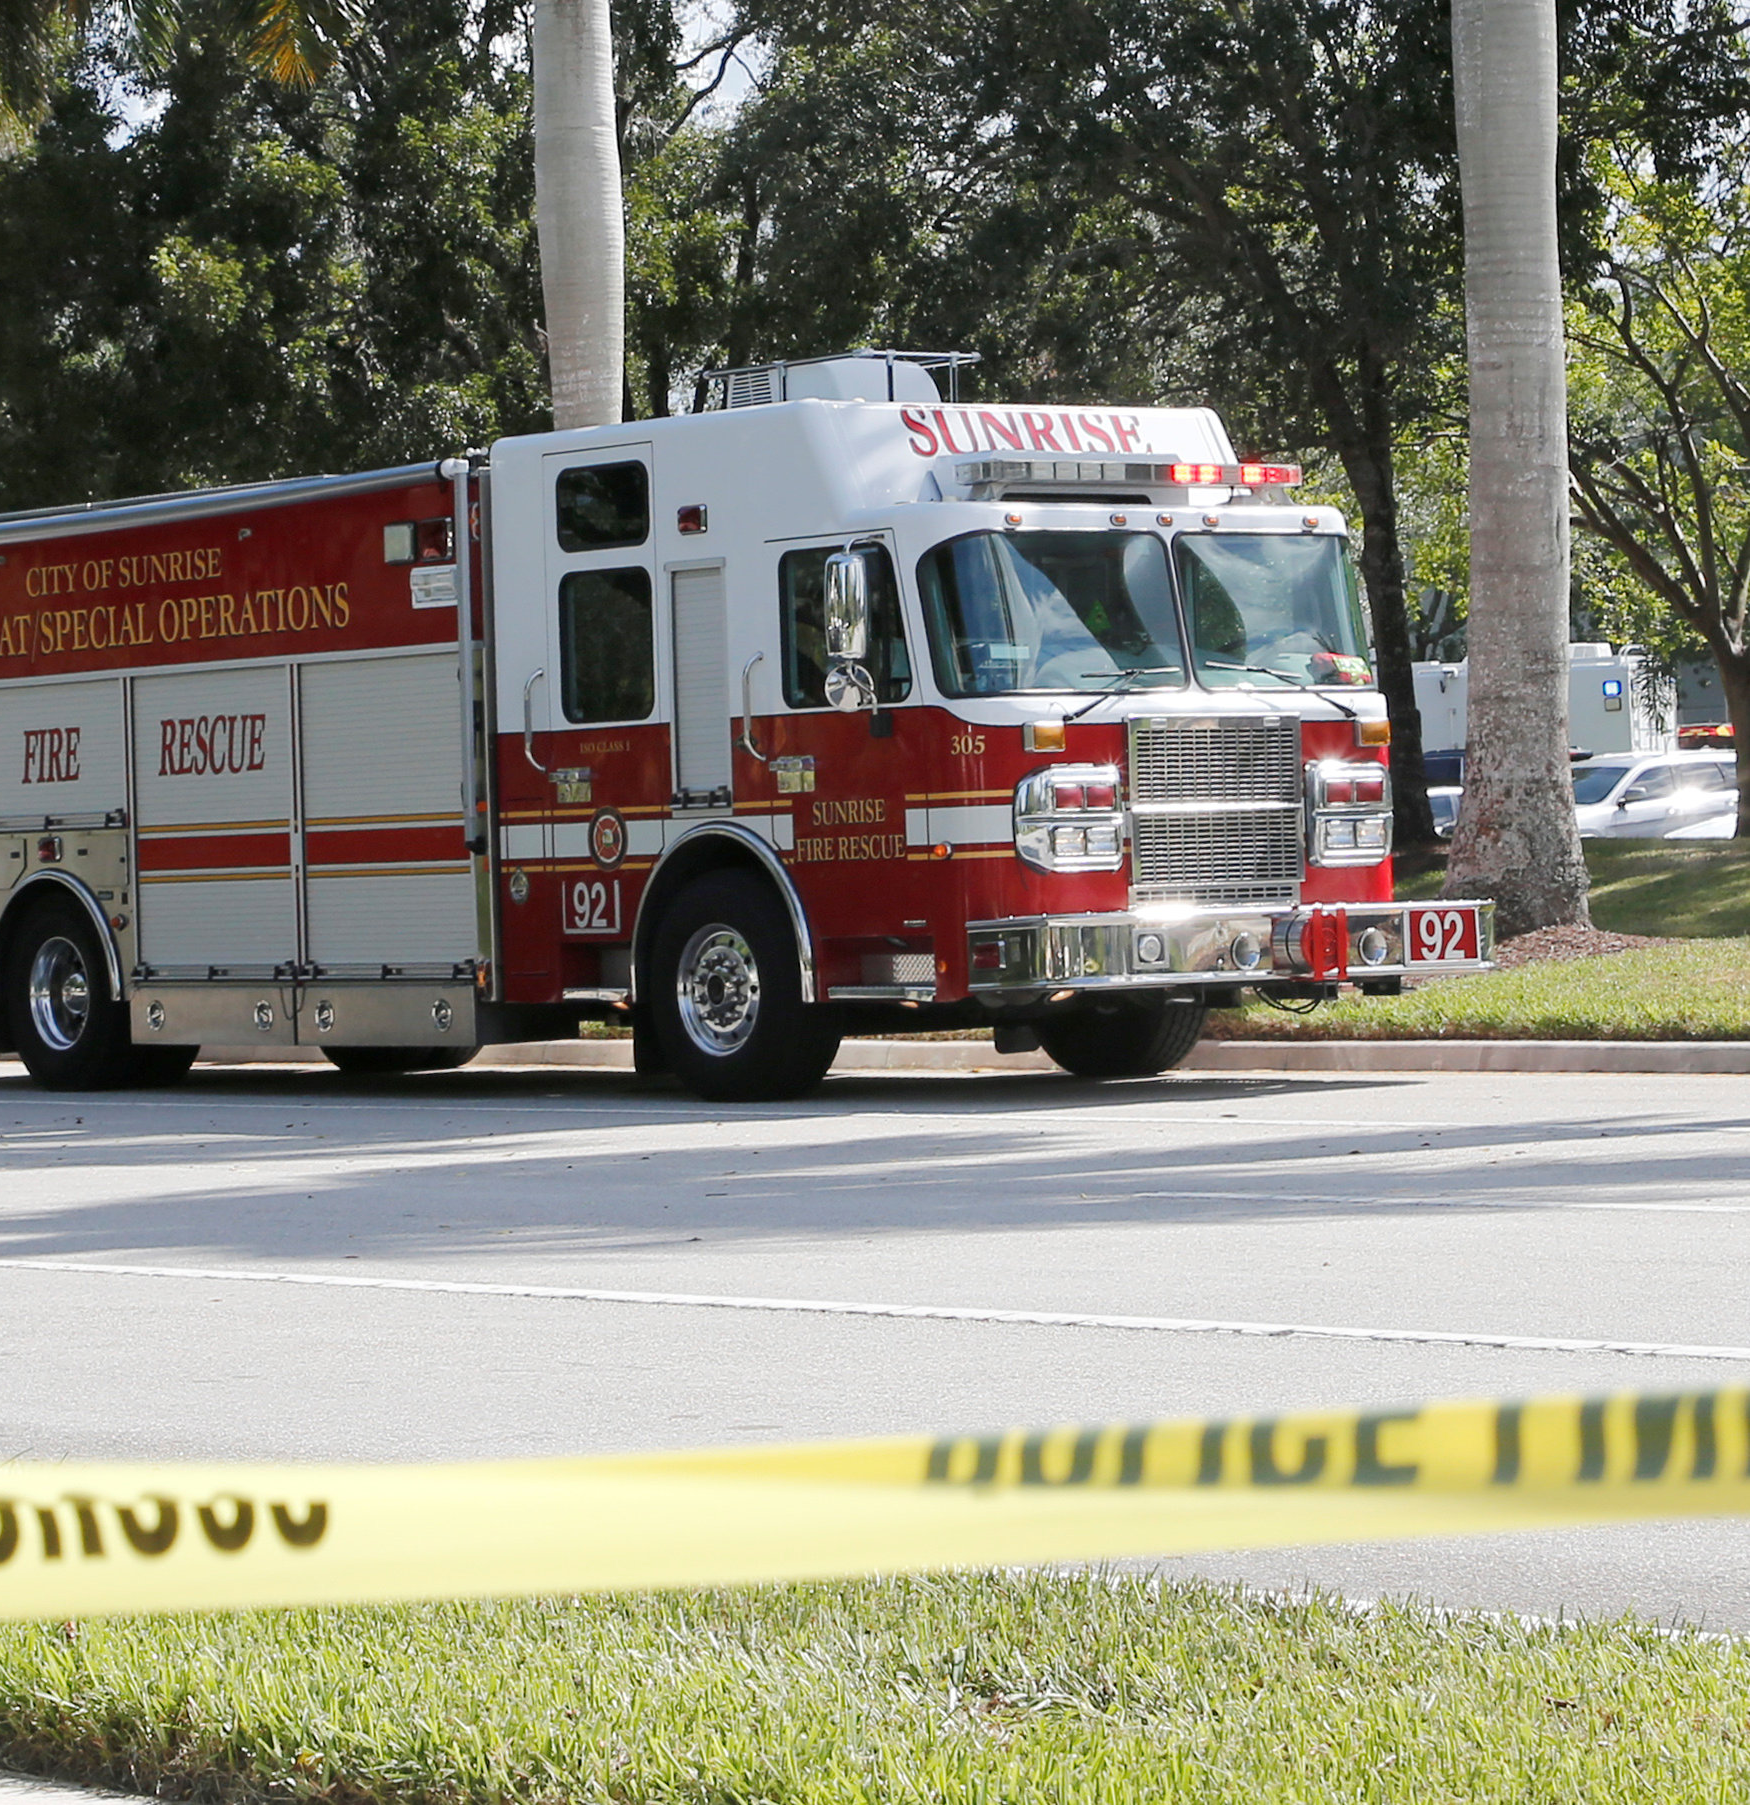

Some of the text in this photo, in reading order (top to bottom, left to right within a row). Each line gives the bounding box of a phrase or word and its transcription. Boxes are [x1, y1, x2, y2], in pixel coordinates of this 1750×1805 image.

[900, 405, 1153, 458] SUNRISE
[25, 547, 222, 598] CITY OF SUNRISE
[158, 581, 351, 644] OPERATIONS
[21, 713, 266, 784] FIRE RESCUE
[950, 735, 986, 755] 305
[812, 799, 886, 826] SUNRISE
[796, 834, 906, 862] FIRE RESCUE
[572, 881, 608, 928] 92
[1419, 910, 1465, 960] 92
